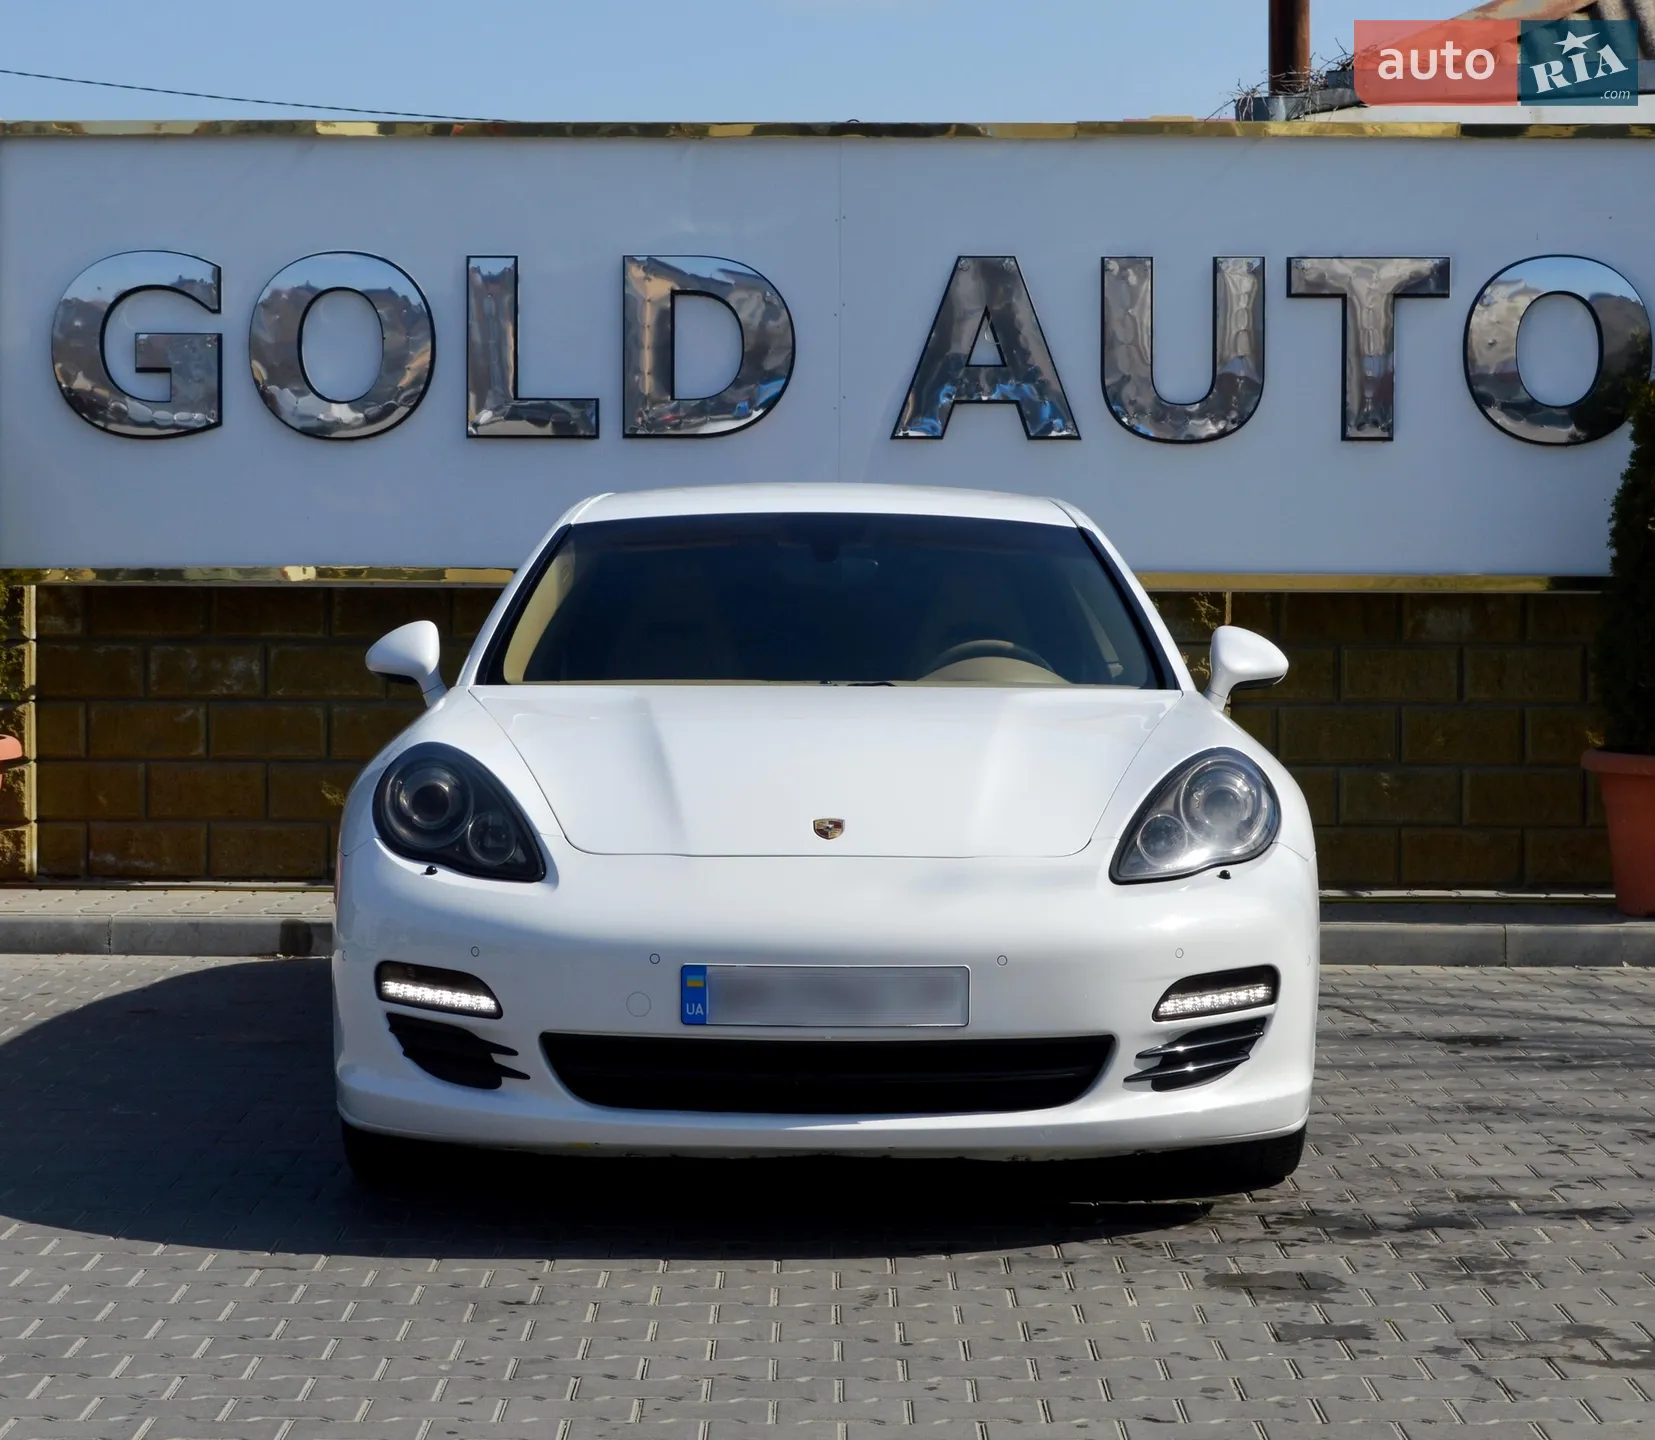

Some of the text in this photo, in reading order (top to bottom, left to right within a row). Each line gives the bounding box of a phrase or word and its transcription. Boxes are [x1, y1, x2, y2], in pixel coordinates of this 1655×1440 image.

[50, 250, 1653, 447] GOLD AUTO
[686, 1003, 704, 1016] UA
